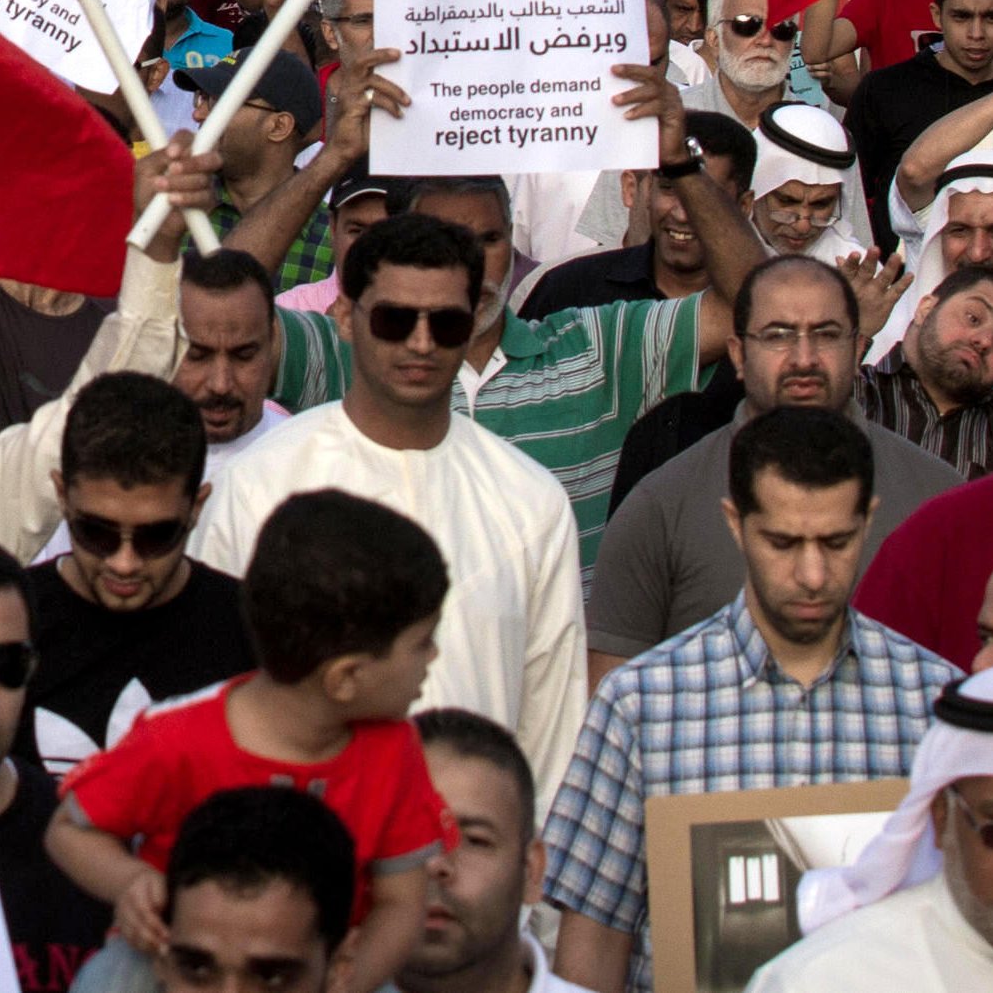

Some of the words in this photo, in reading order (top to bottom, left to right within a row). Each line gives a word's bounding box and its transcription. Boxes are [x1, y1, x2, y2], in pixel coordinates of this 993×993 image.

[50, 2, 82, 26] and
[405, 2, 504, 25] بالديمقراطية
[509, 1, 561, 20] يطالب
[405, 26, 520, 59] الاستبداد
[529, 27, 627, 55] ويرفض
[430, 82, 462, 97] The
[468, 79, 525, 99] people
[530, 77, 601, 94] demand
[450, 106, 544, 122] democracy
[550, 103, 583, 118] and
[436, 126, 501, 150] reject
[509, 125, 598, 149] tyranny
